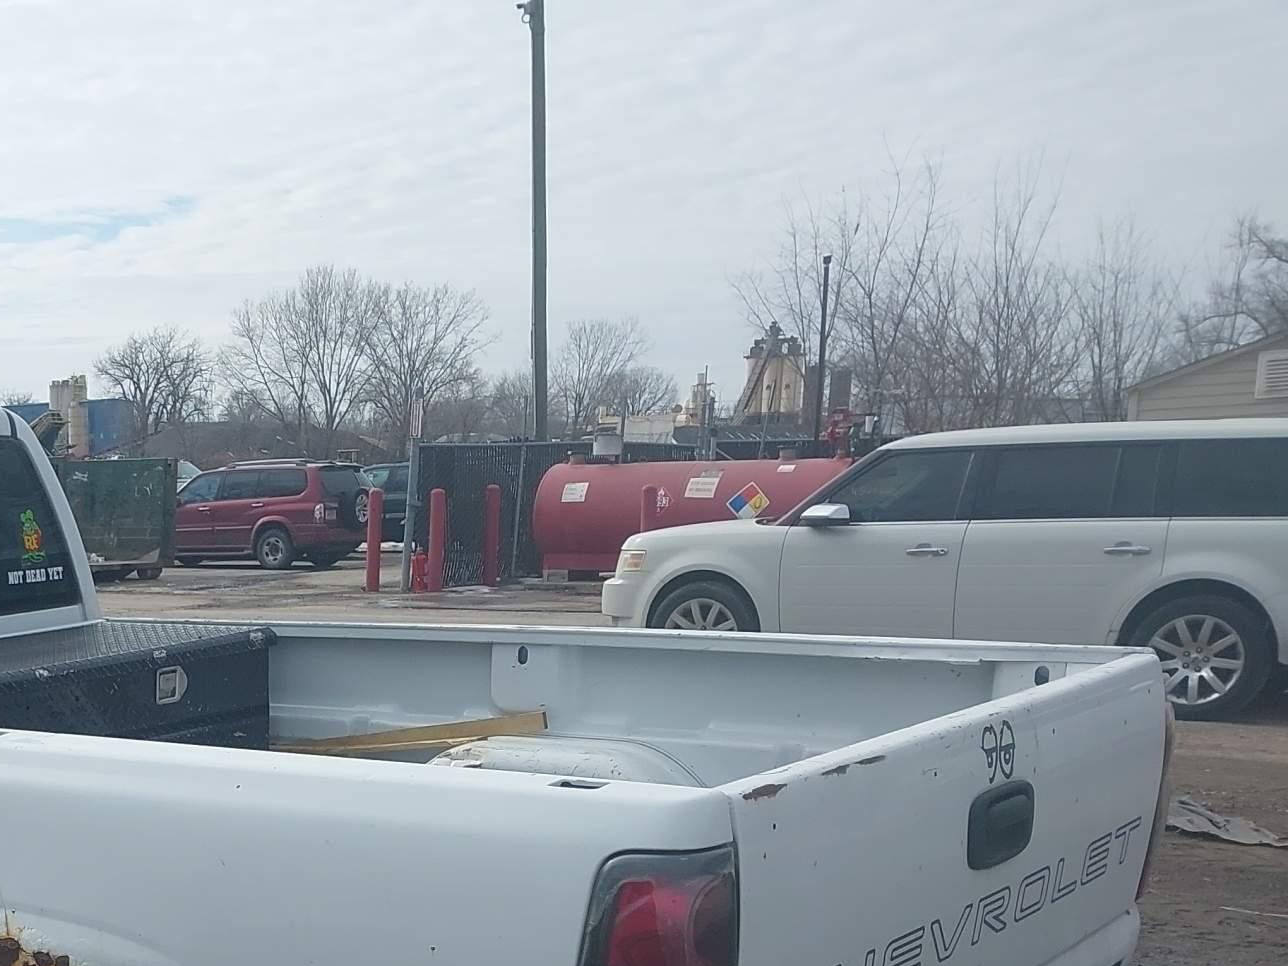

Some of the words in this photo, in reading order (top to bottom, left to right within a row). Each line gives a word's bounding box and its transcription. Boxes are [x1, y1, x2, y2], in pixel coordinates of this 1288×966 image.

[7, 570, 24, 585] NOT
[26, 568, 46, 583] DEAD
[47, 565, 64, 580] YET
